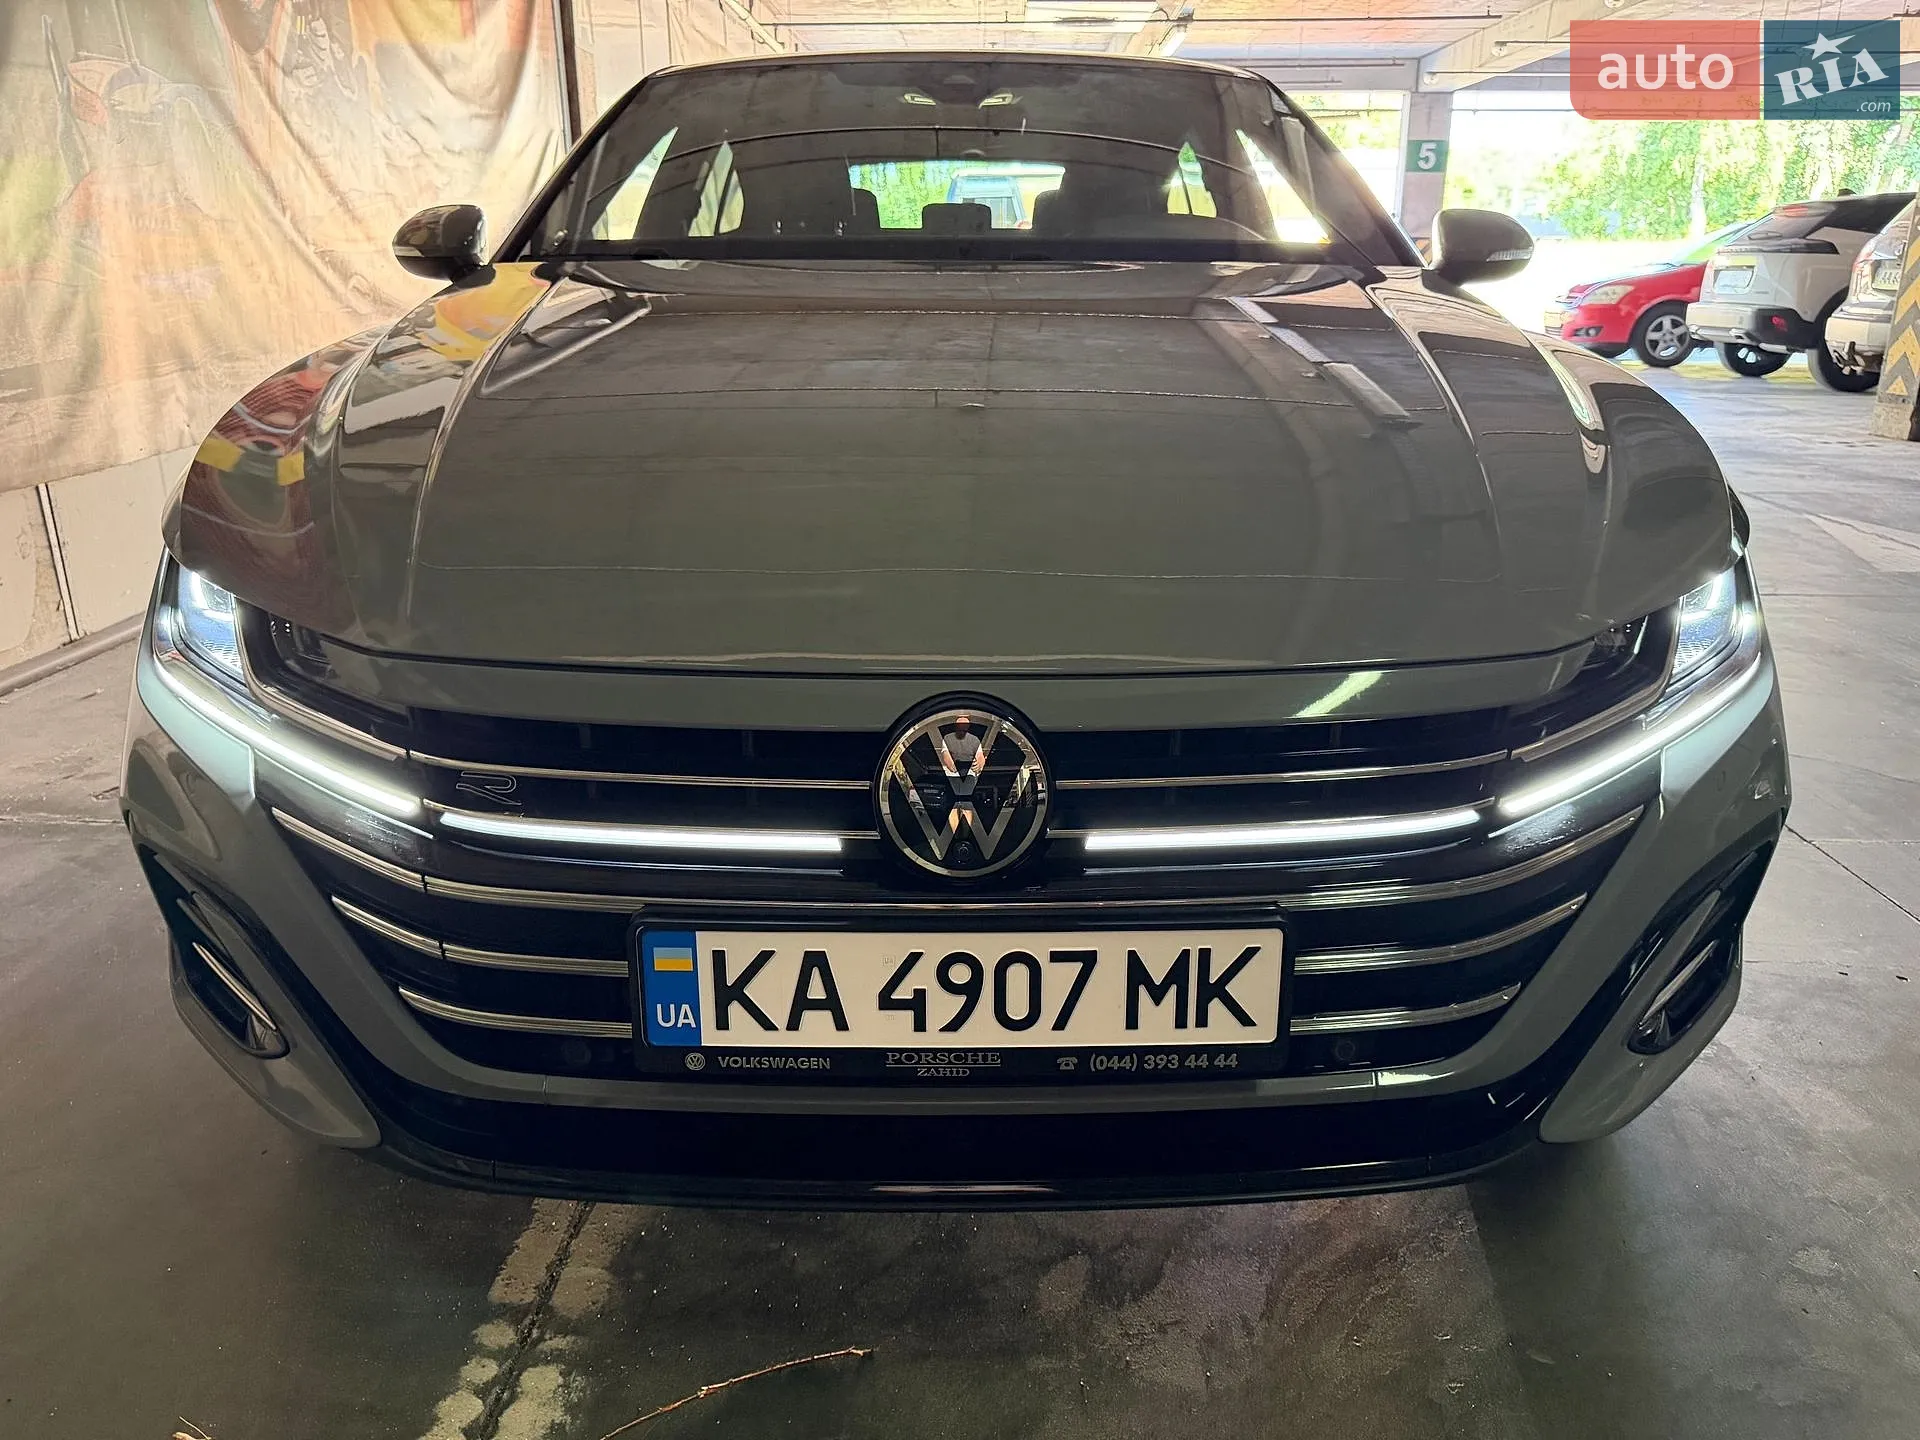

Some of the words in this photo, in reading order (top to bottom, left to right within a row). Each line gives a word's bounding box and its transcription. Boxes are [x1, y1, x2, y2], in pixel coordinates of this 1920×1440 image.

[1417, 142, 1437, 170] 5
[711, 949, 850, 1032] KA
[877, 949, 1098, 1033] 4907
[1125, 945, 1261, 1030] MK
[656, 1003, 697, 1028] UA
[717, 1055, 831, 1070] VOLKSWAGEN
[885, 1052, 1001, 1065] PORSCHE
[1089, 1053, 1138, 1072] (044)
[1144, 1054, 1179, 1069] 393
[1184, 1053, 1209, 1068] 44
[1213, 1052, 1238, 1068] 44
[916, 1067, 970, 1077] ZAHID
